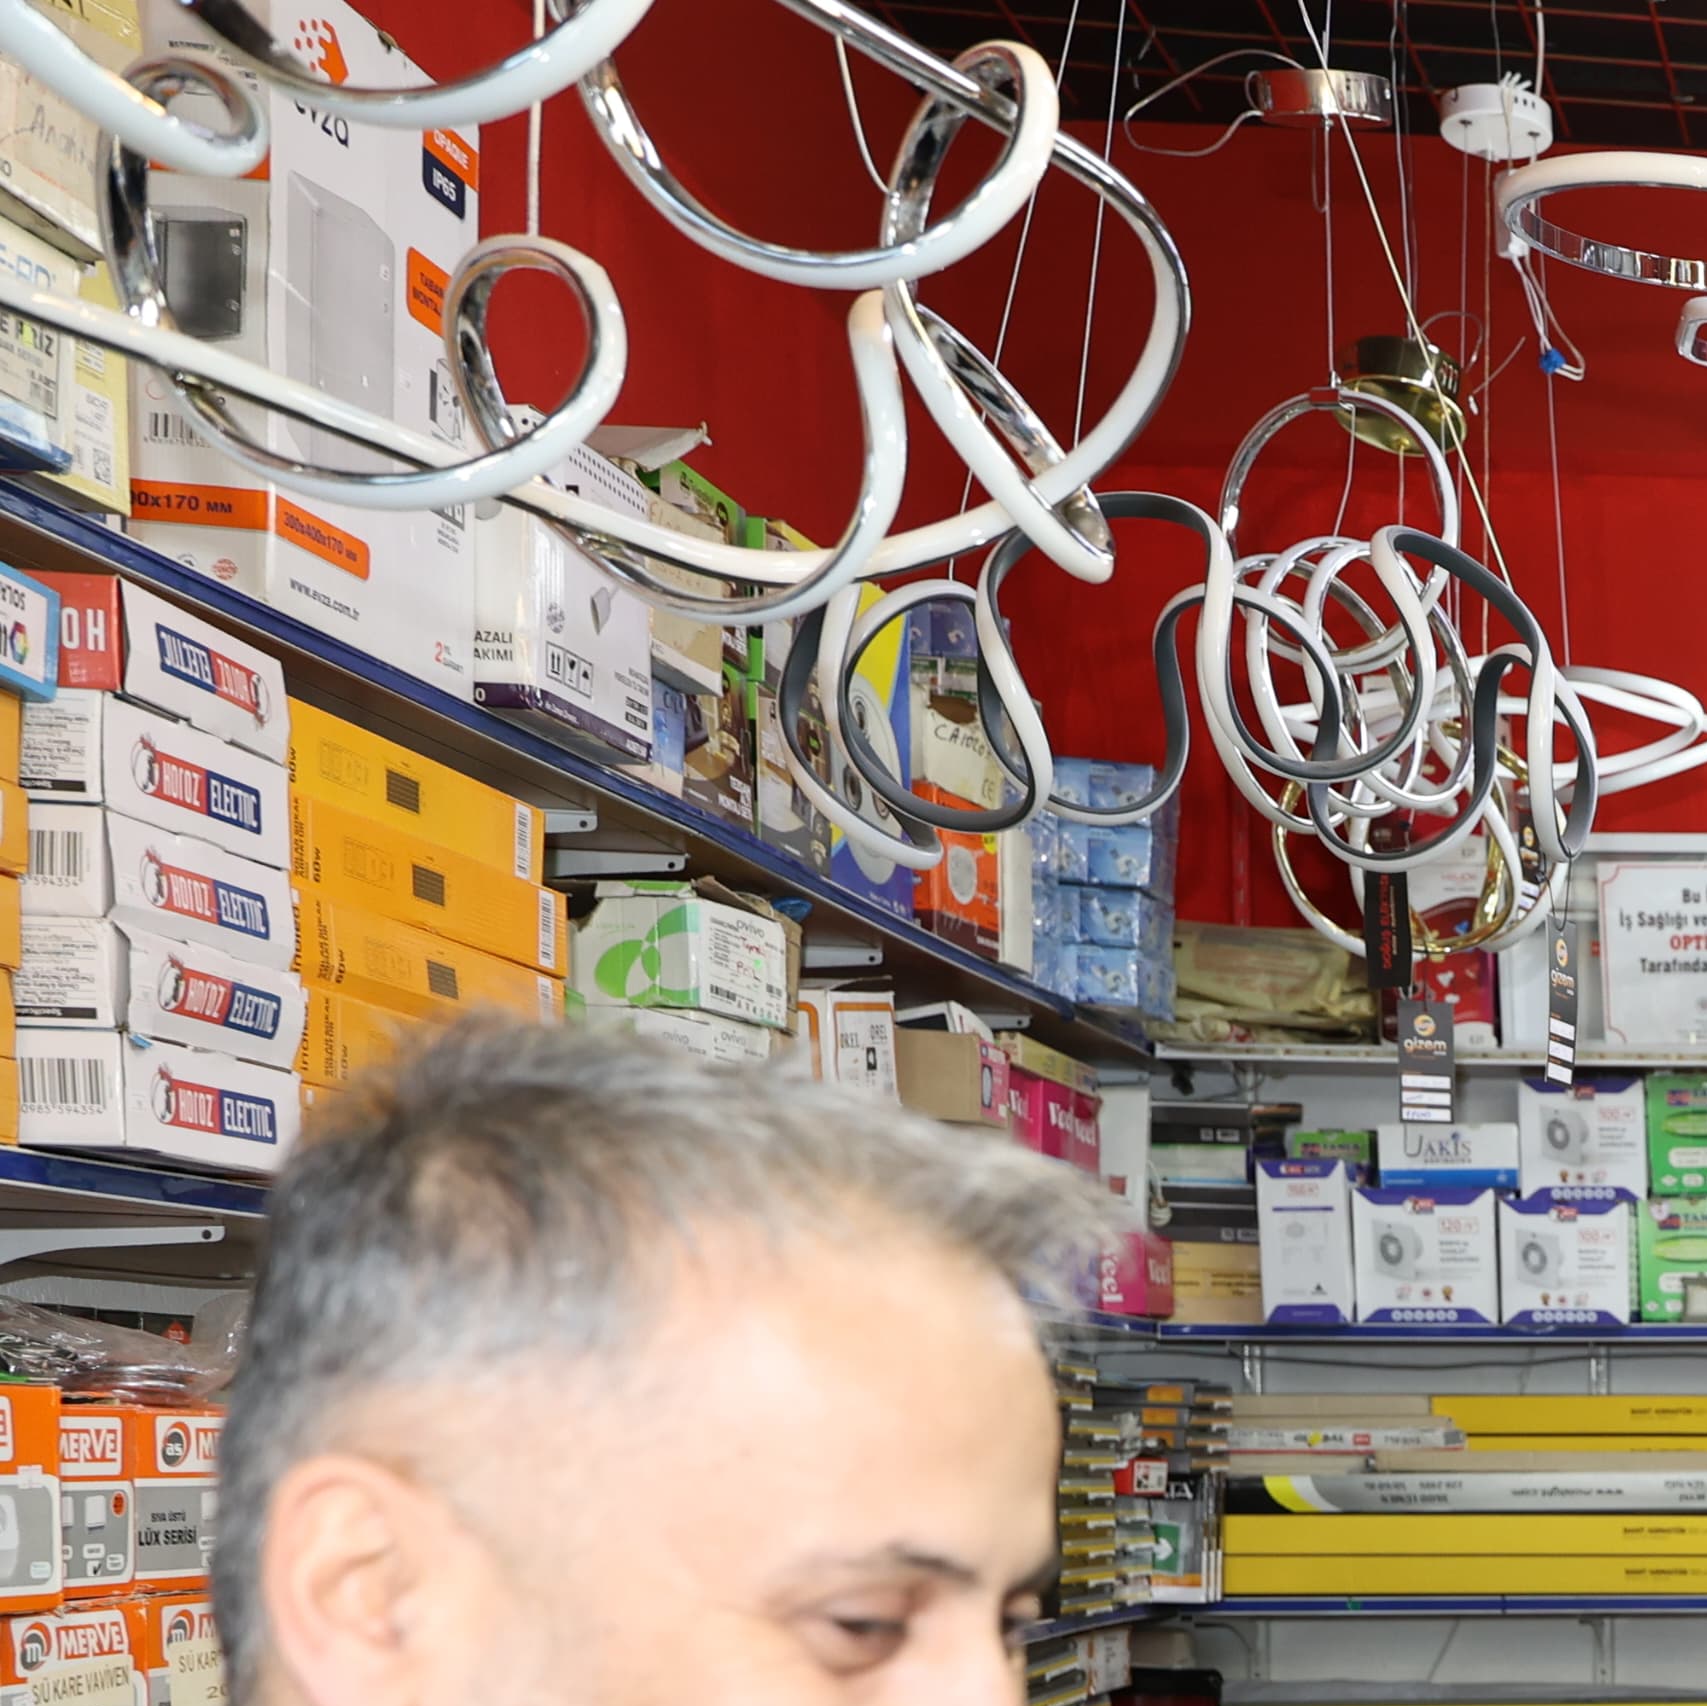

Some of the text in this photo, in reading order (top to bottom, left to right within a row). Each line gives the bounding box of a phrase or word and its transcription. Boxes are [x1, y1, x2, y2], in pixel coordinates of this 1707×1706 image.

[433, 168, 456, 201] IP65
[1682, 889, 1700, 903] Bu
[1619, 908, 1632, 930] İş
[1637, 909, 1688, 930] Sağlığı
[1692, 914, 1707, 926] ve
[1551, 968, 1575, 989] gizem
[1404, 1037, 1447, 1053] gizem
[138, 1529, 161, 1546] LÜX
[59, 1624, 123, 1657] MERVE
[52, 1674, 84, 1701] KARE
